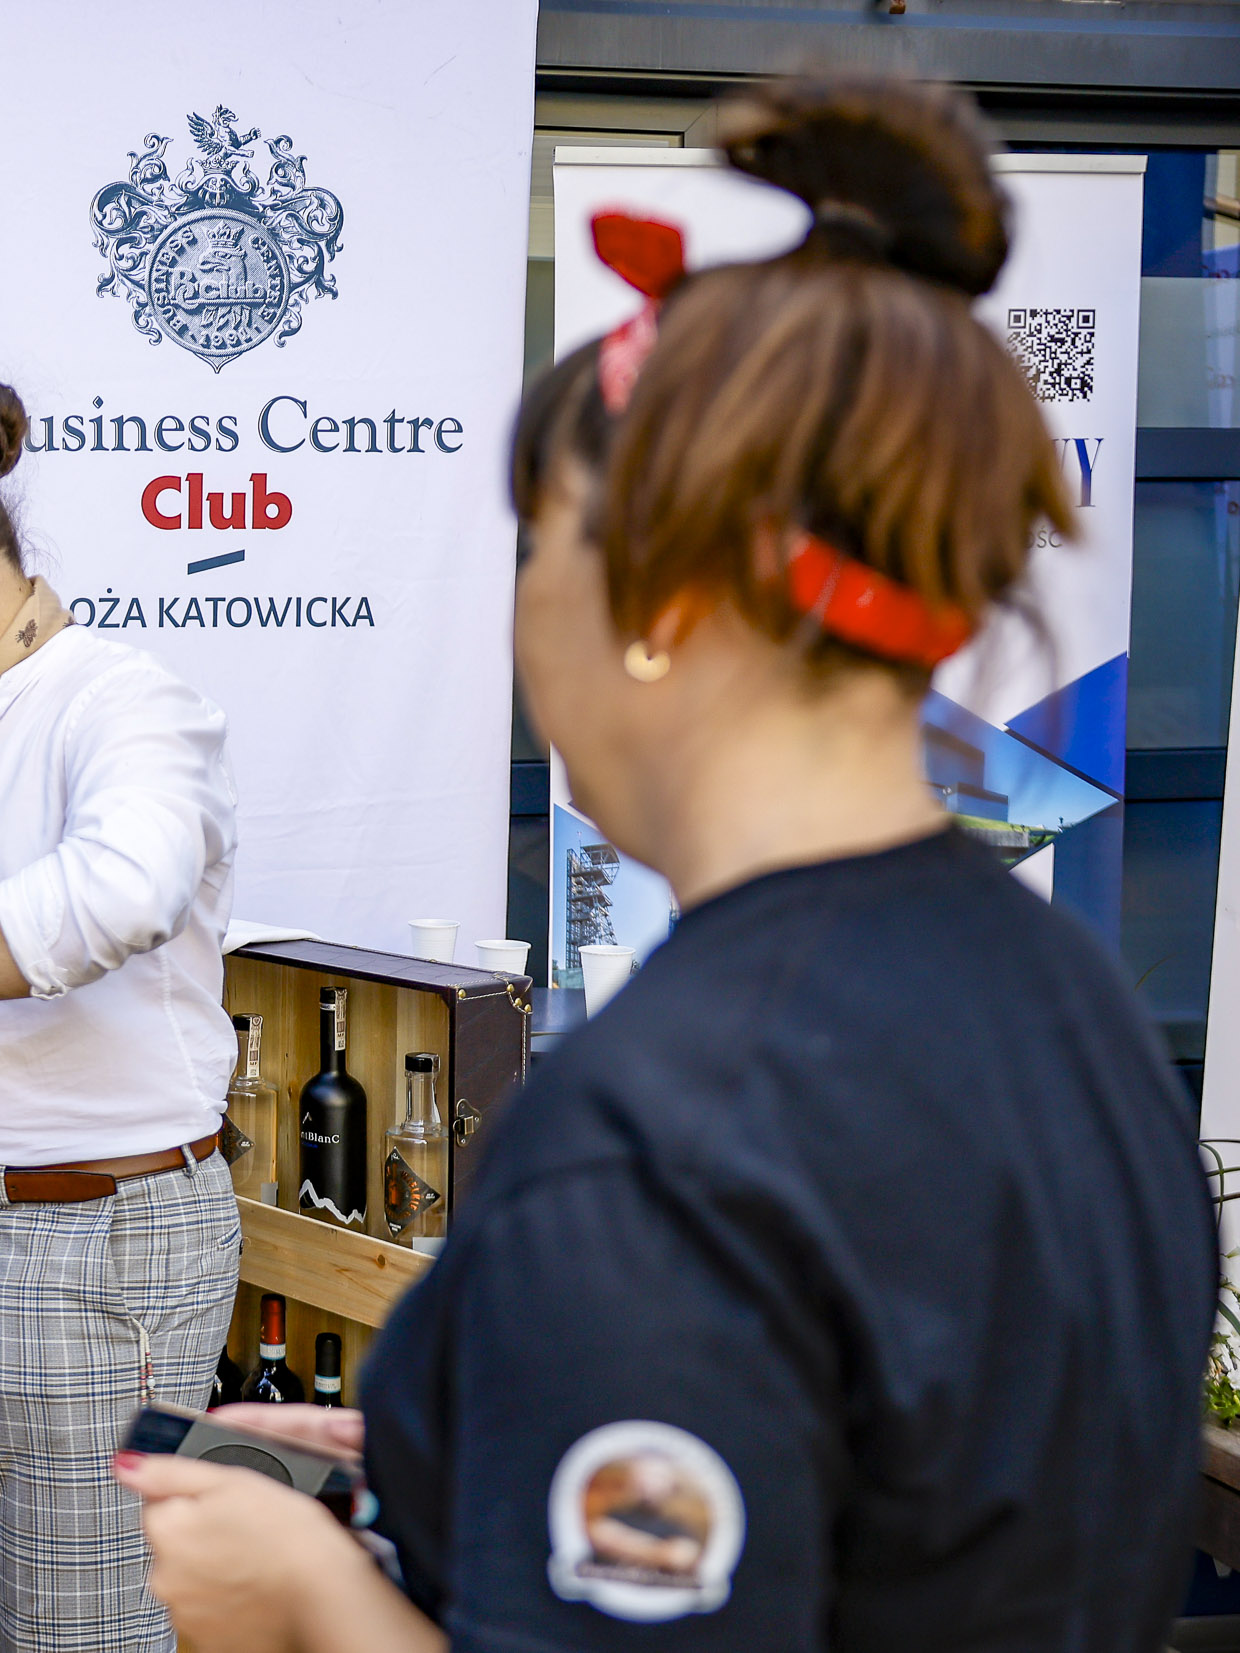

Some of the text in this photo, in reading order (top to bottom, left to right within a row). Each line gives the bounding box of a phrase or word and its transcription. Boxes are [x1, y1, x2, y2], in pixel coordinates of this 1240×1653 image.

[22, 395, 464, 454] usiness Centre
[140, 472, 293, 531] Club
[69, 587, 375, 629] OŻA KATOWICKA
